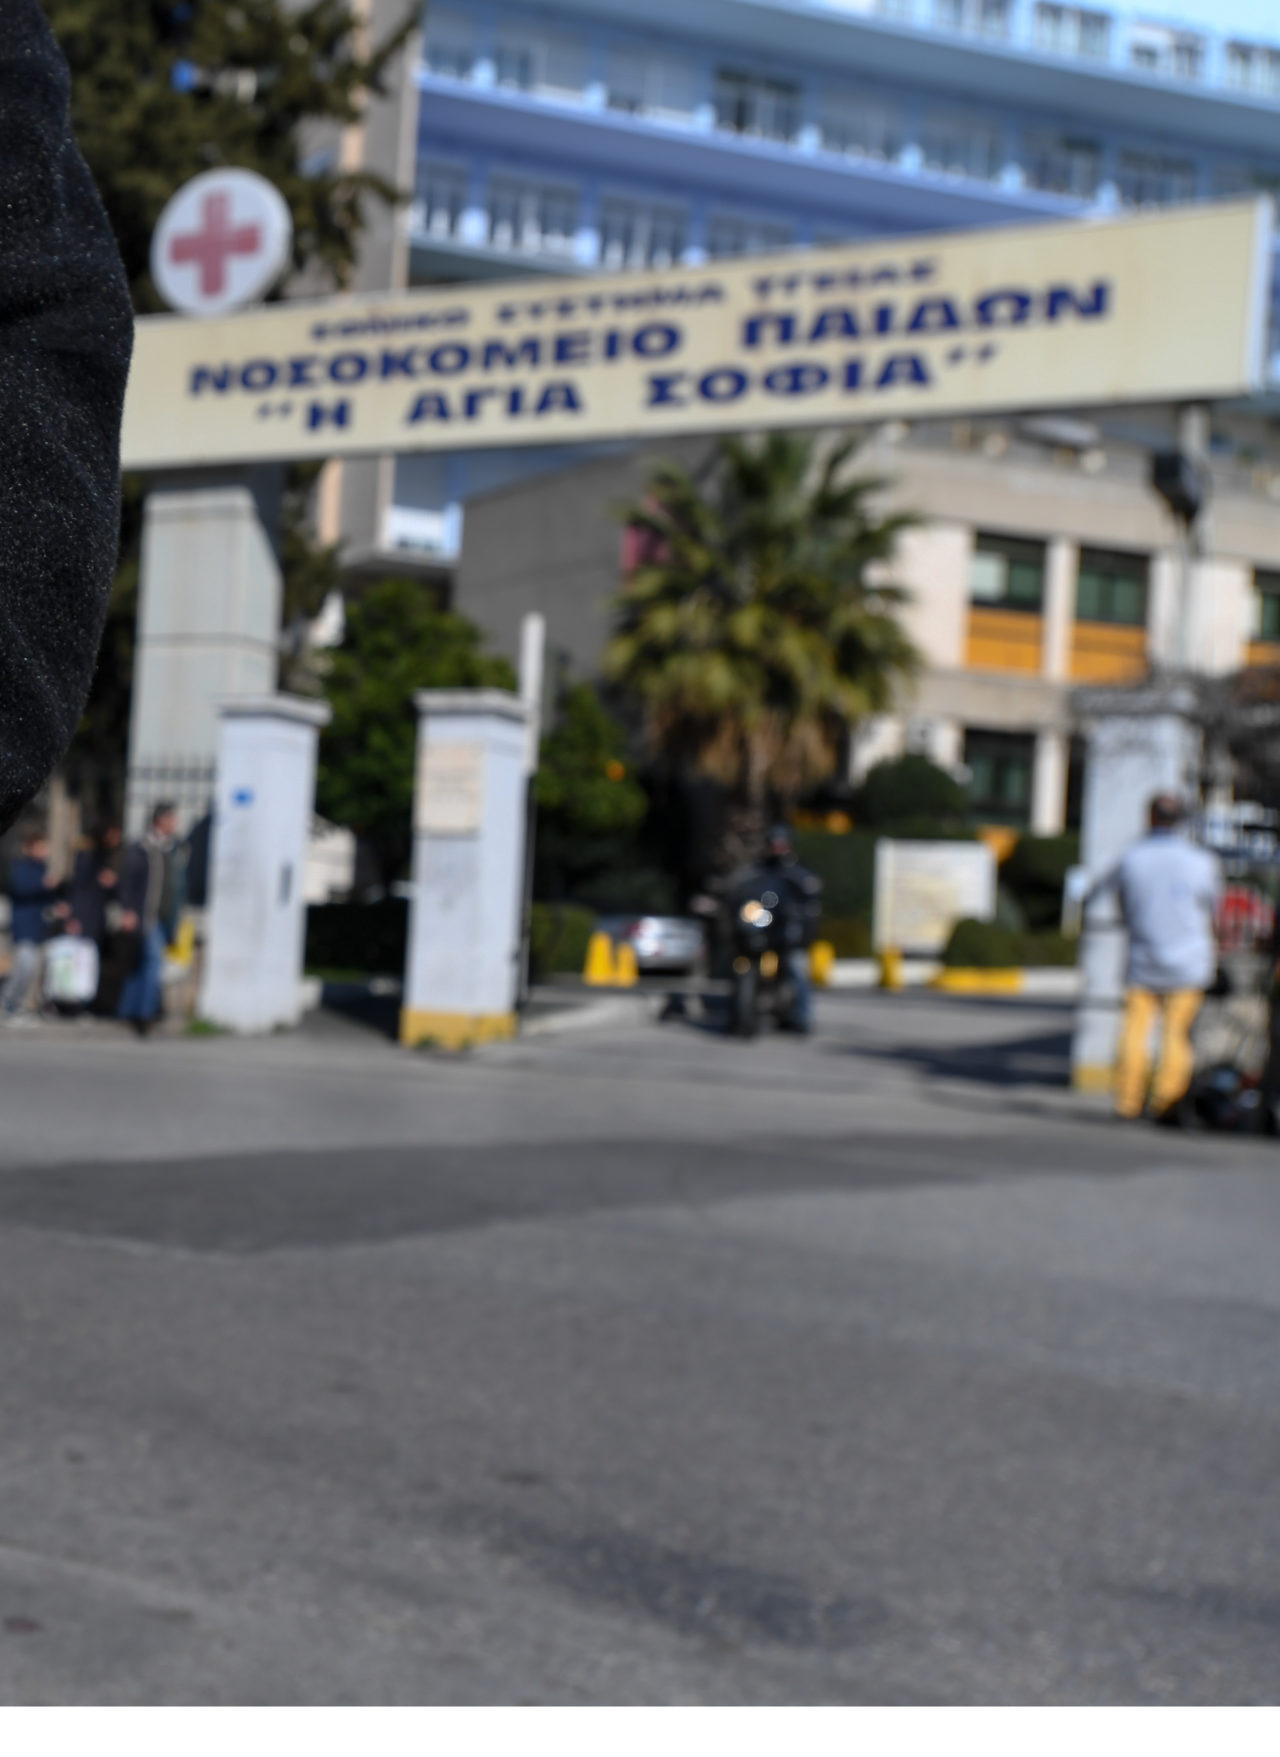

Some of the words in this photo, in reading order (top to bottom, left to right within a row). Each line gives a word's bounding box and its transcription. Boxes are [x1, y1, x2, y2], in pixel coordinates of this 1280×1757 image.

[189, 321, 682, 397] ΝΟΣΟΚΟΜΕΙΟ
[742, 279, 1112, 348] ΠΑΙΔΩΝ
[407, 377, 584, 428] ΑΓΙΑ
